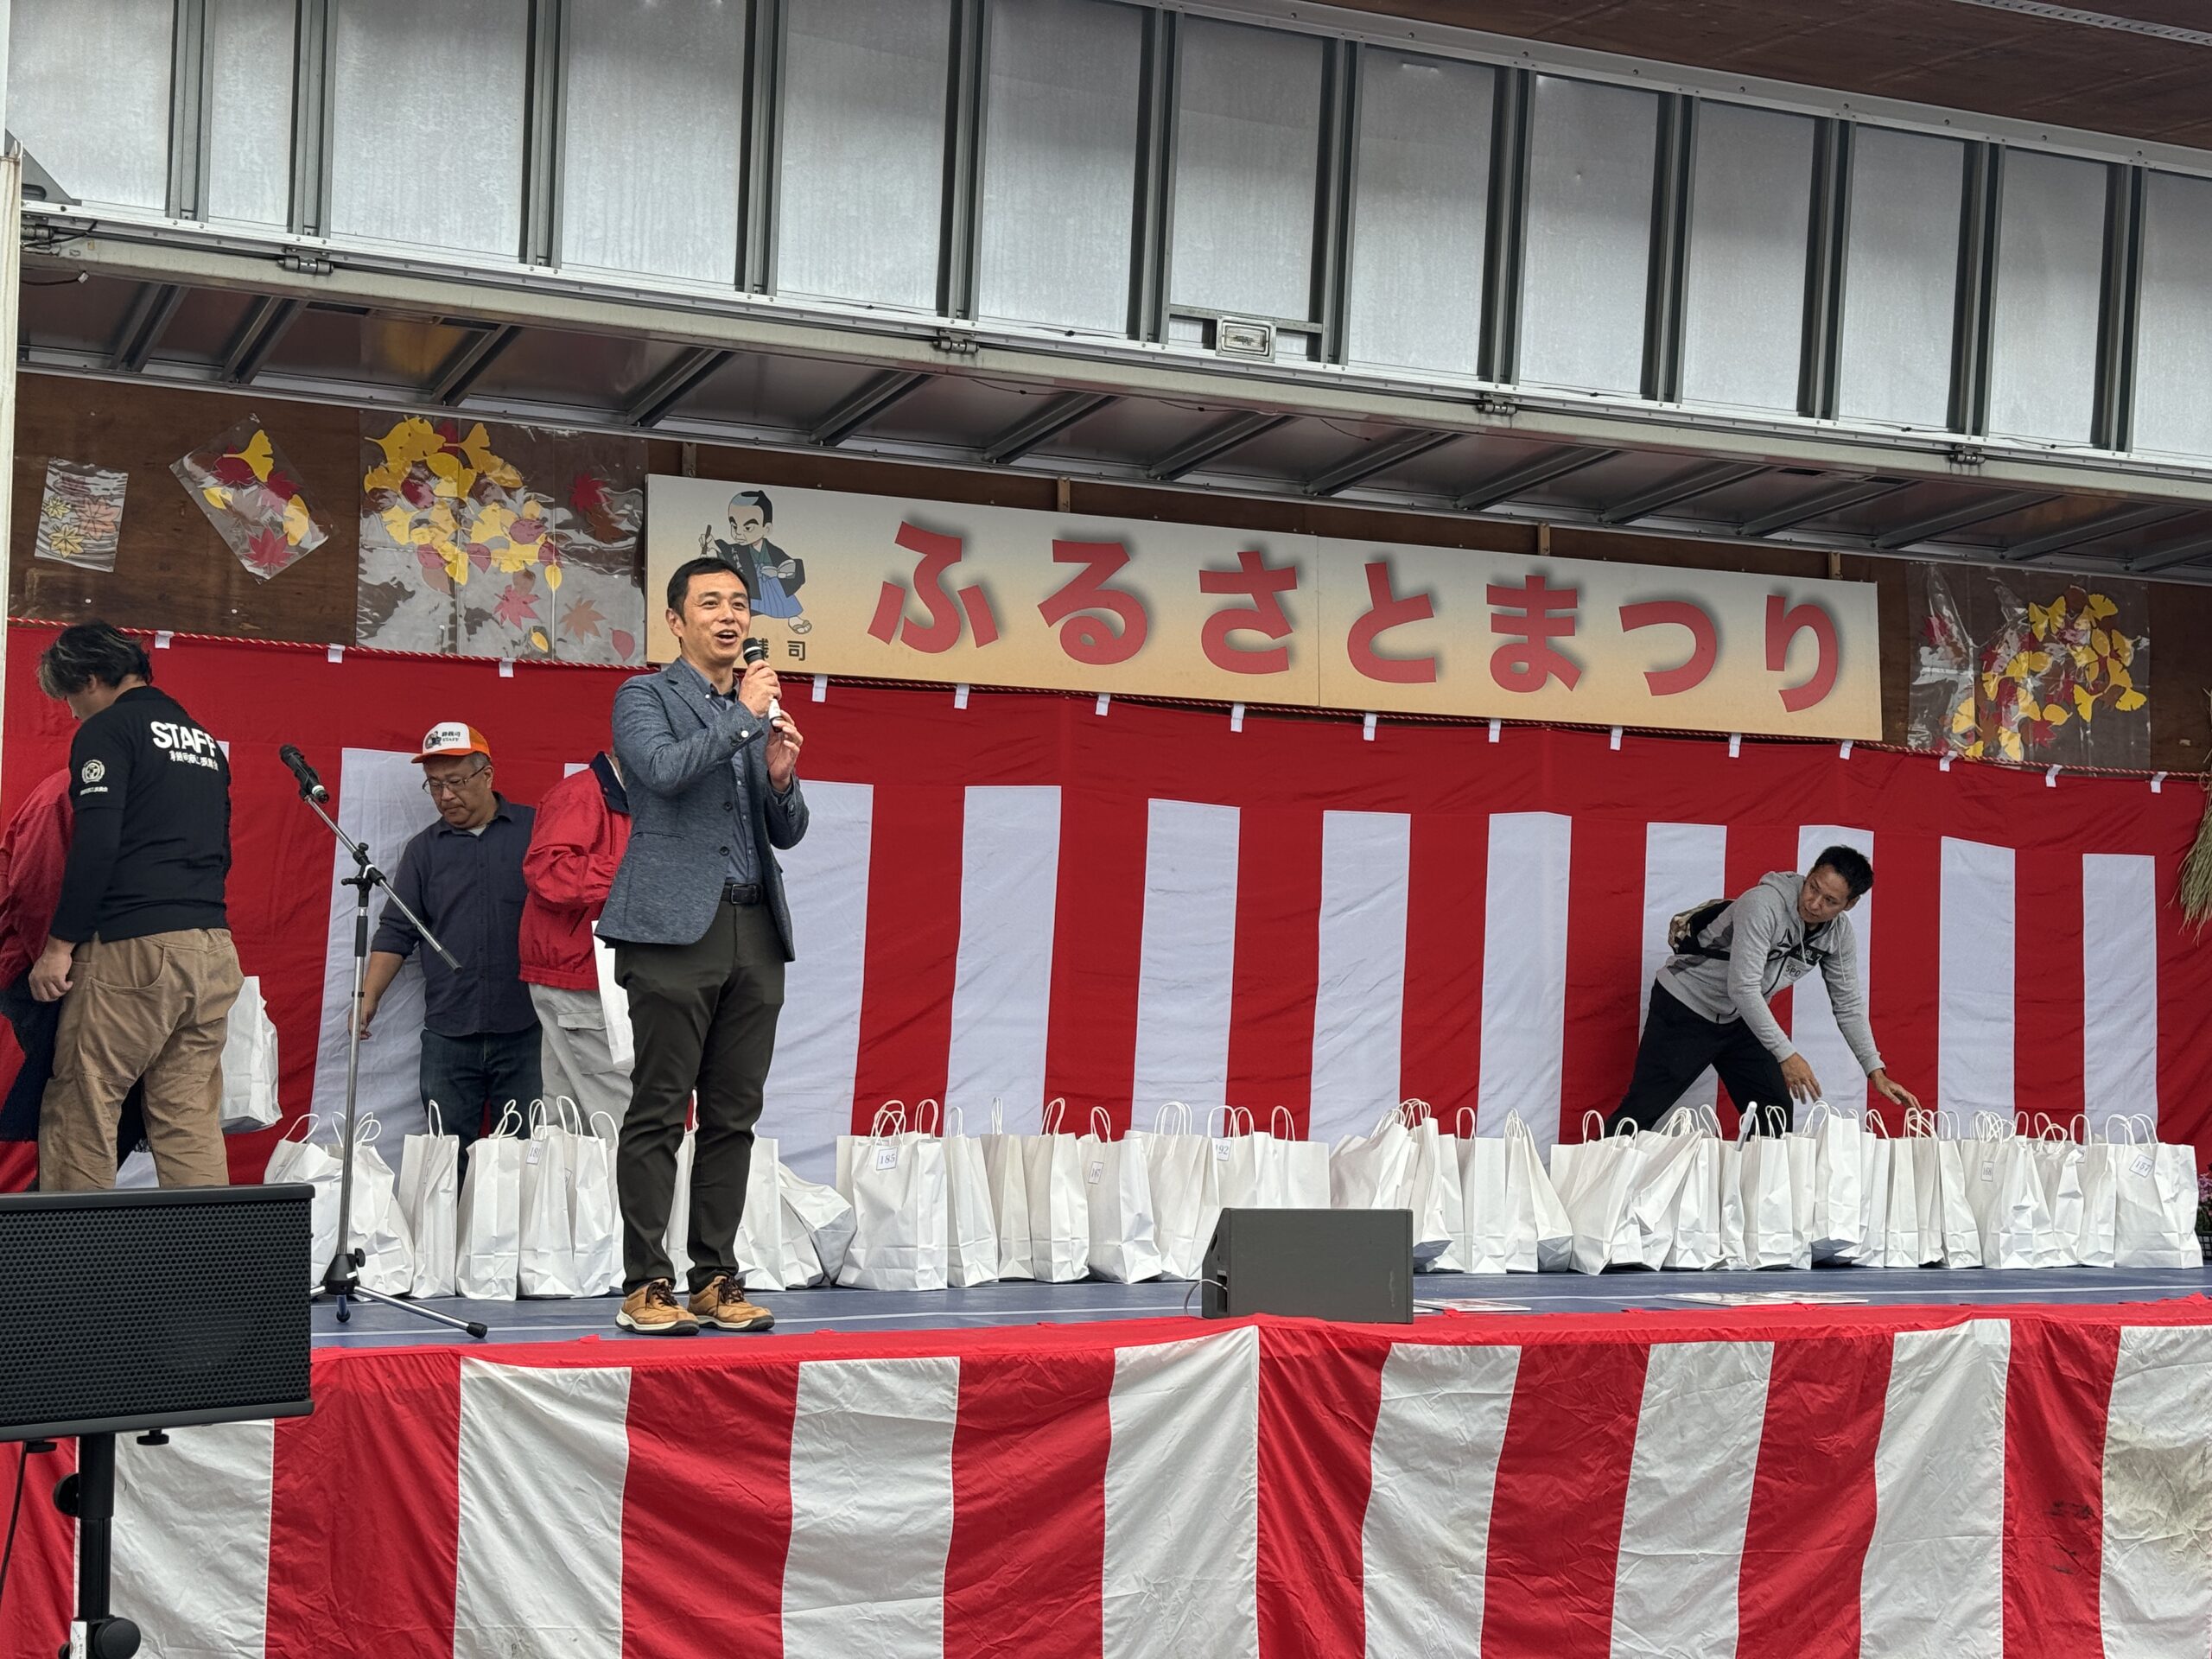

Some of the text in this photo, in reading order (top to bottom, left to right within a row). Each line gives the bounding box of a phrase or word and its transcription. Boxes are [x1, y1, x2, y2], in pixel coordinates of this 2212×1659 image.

[868, 520, 1840, 713] ふるさとまつり
[150, 721, 216, 757] STAFF
[880, 1154, 895, 1165] 185
